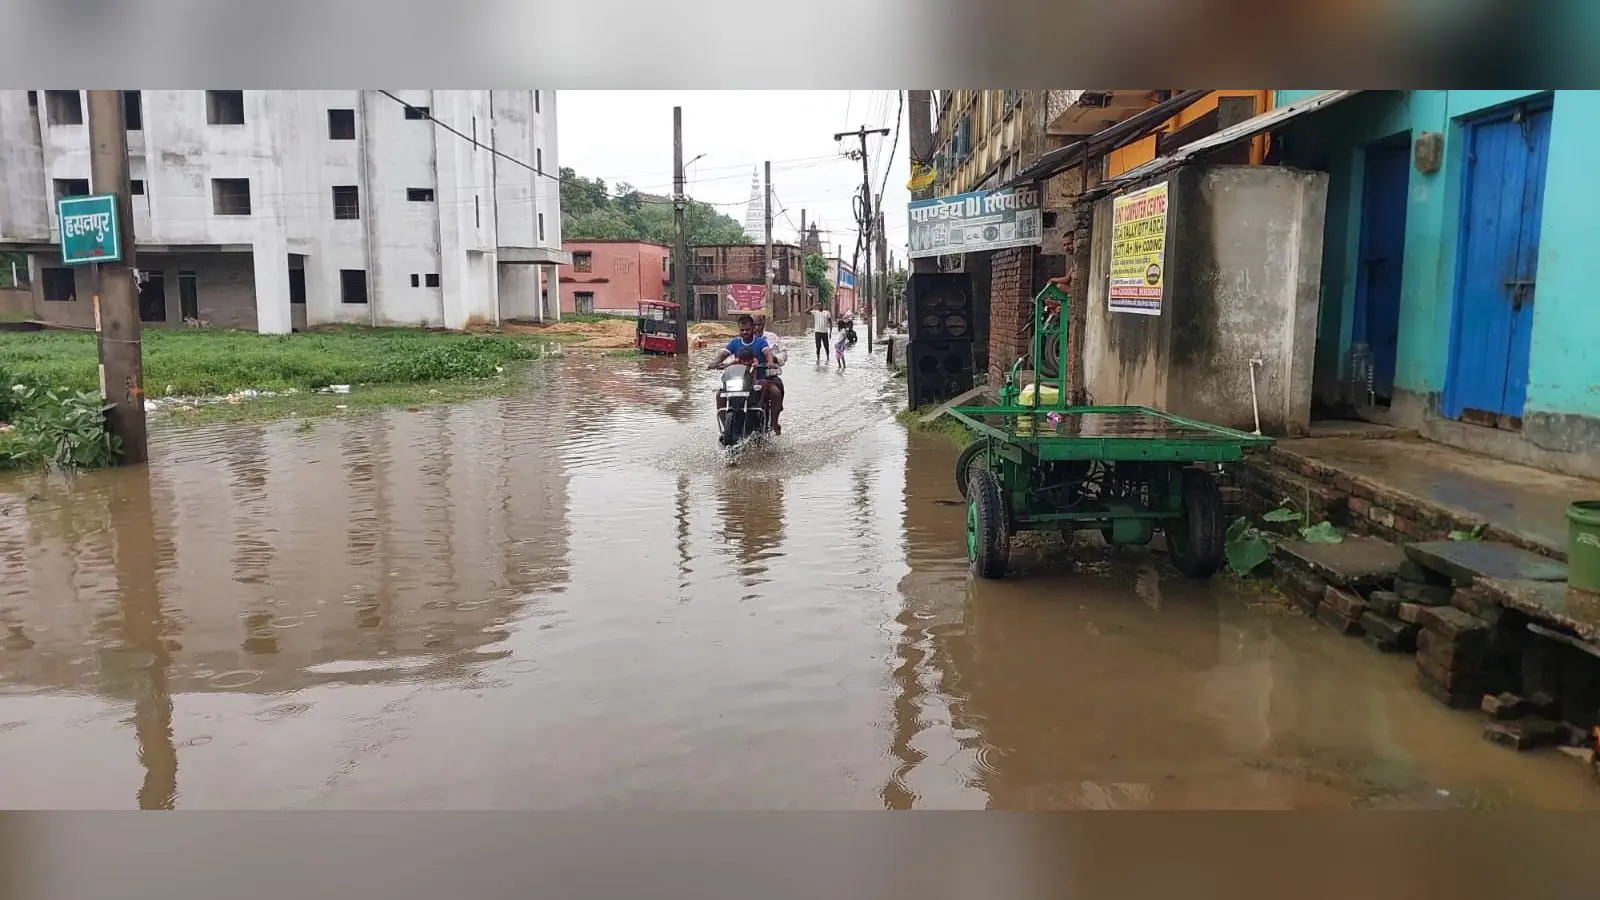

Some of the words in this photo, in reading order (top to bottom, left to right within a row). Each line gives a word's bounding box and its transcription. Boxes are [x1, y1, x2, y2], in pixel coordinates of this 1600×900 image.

[910, 200, 965, 223] पाण्डेय
[966, 196, 981, 218] DJ
[1124, 199, 1146, 222] COMPUTER
[1146, 194, 1165, 215] CENTRE
[64, 212, 110, 242] हसनपुर
